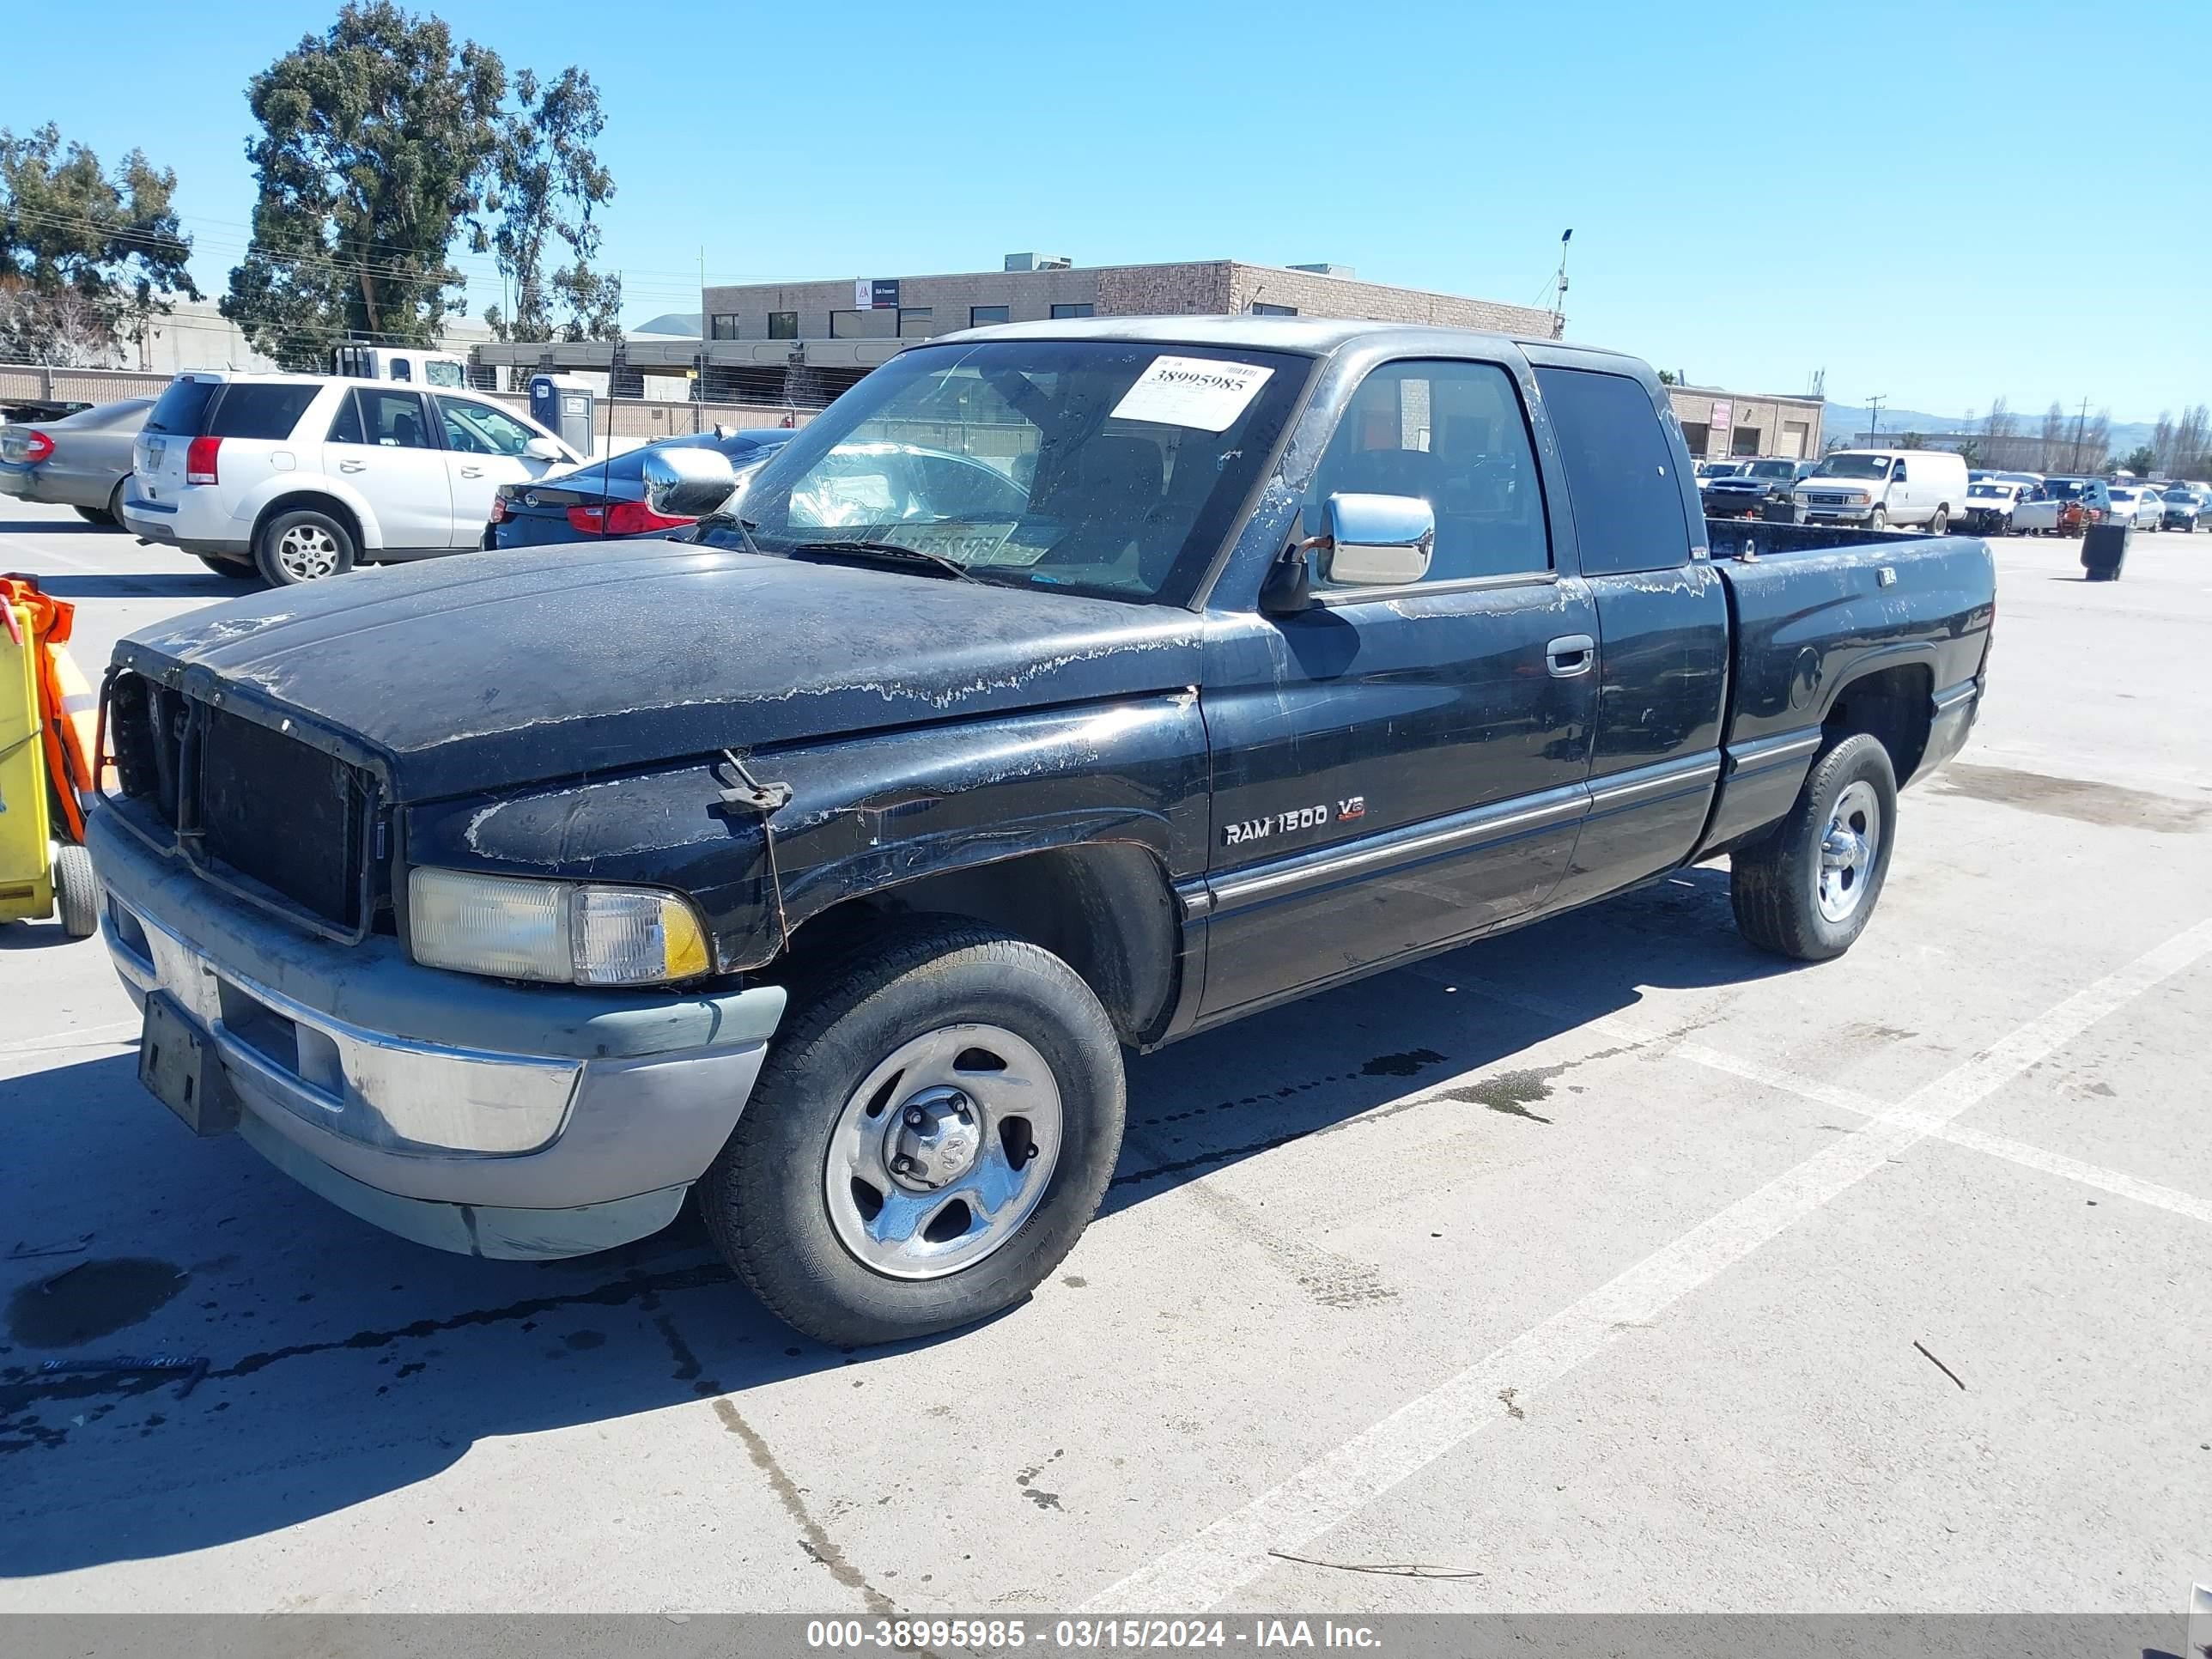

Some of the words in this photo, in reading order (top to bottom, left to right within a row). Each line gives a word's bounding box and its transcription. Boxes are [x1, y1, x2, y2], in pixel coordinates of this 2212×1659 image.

[1152, 369, 1248, 392] 38995985
[1224, 817, 1273, 846] RAM
[1277, 805, 1328, 834] 1500
